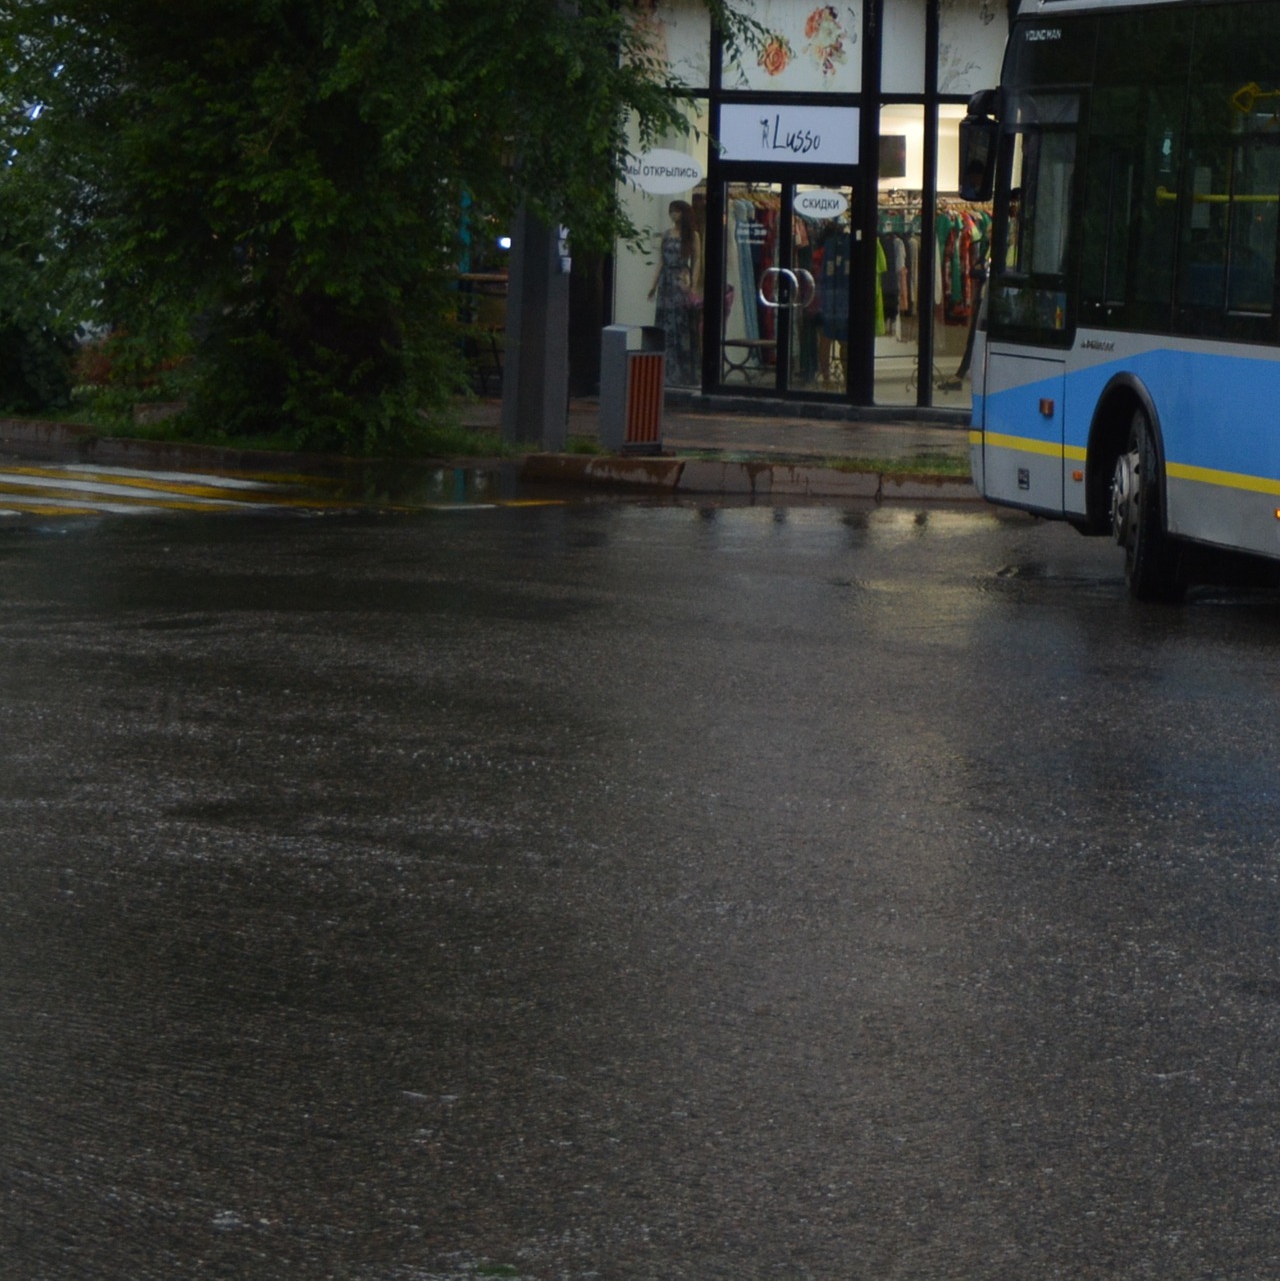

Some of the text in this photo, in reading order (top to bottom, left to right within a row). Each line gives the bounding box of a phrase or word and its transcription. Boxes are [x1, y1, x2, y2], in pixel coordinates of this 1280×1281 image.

[772, 114, 821, 154] Lusso
[642, 165, 698, 178] ОТКРЫЛИСЬ
[802, 198, 839, 210] СКИДКИ
